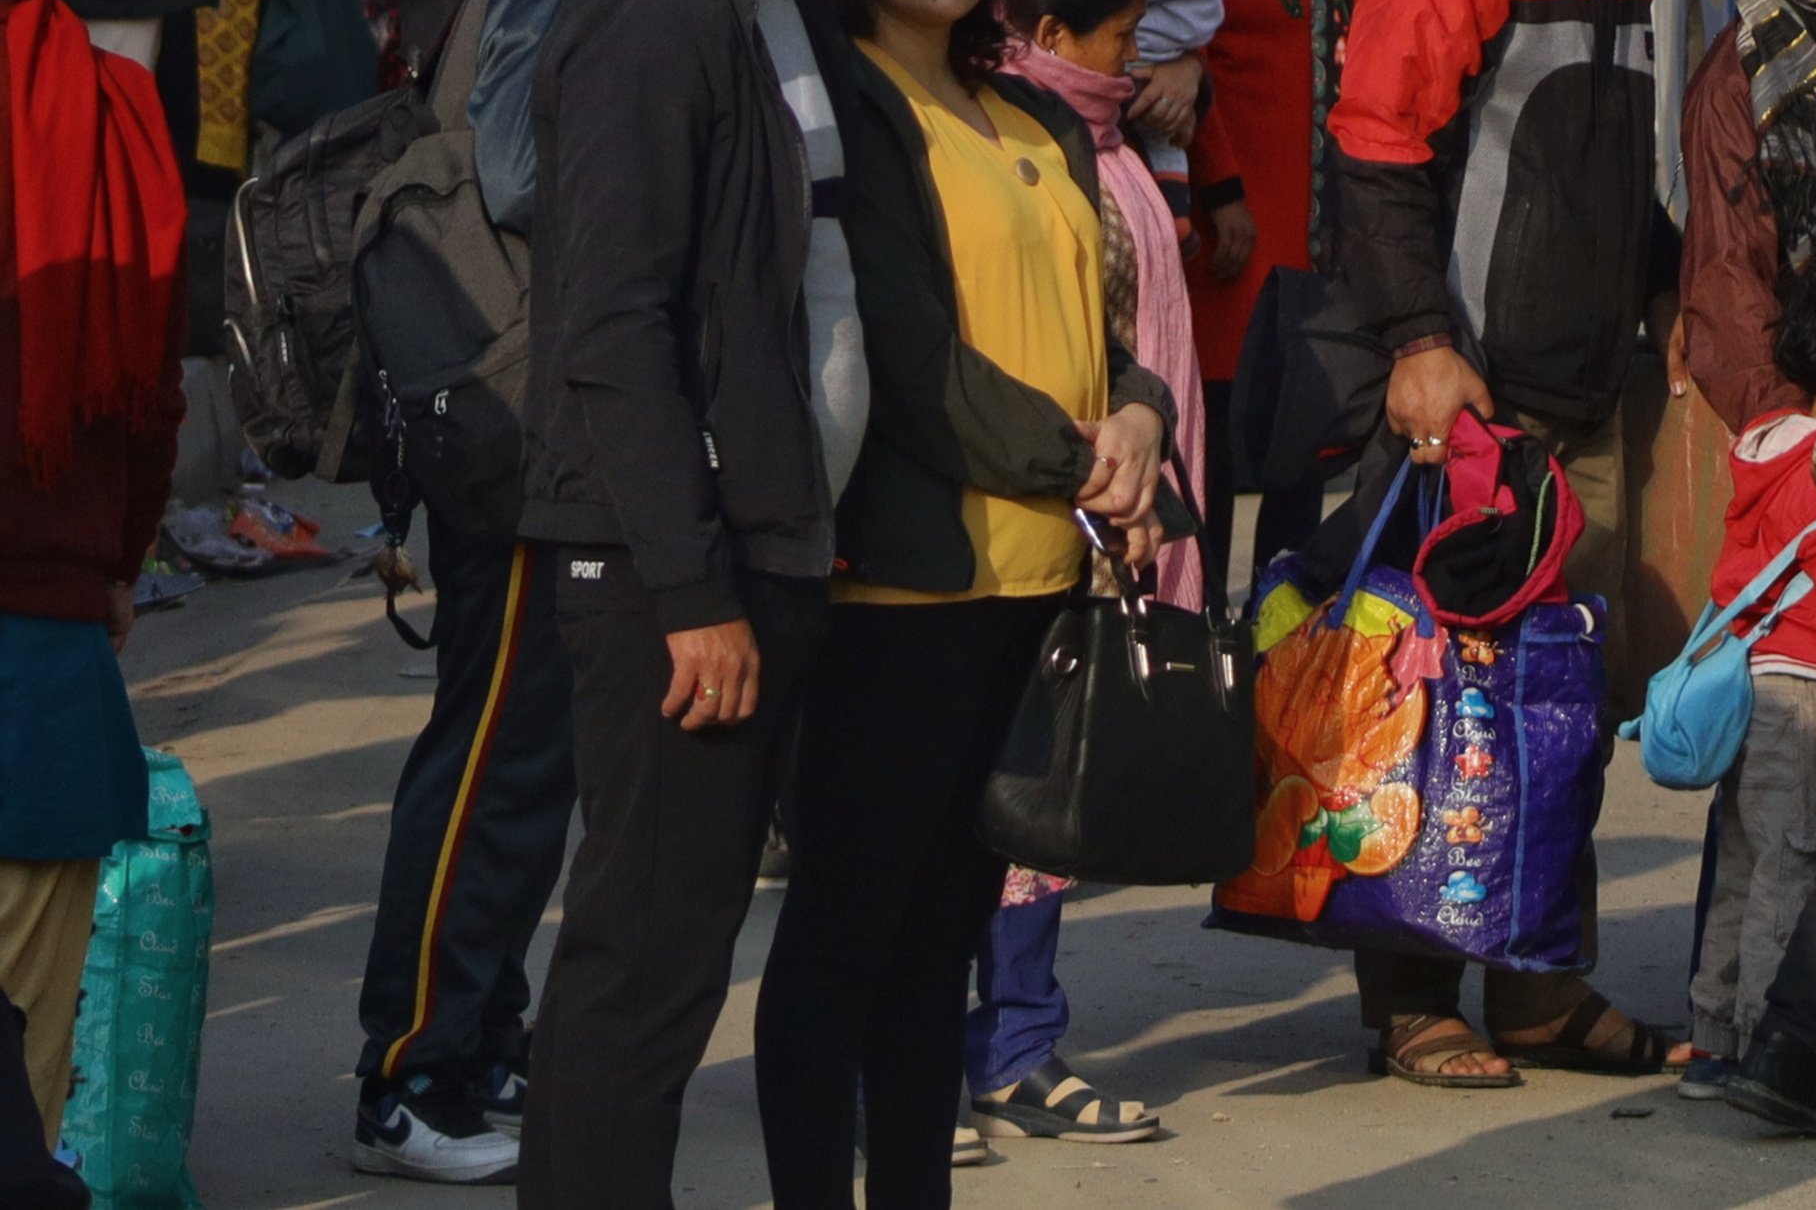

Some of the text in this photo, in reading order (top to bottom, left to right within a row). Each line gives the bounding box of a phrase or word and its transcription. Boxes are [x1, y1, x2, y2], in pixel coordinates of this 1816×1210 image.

[570, 560, 606, 579] SPORT
[1448, 777, 1490, 803] Star
[1447, 846, 1483, 867] Bee
[1436, 904, 1485, 927] Cloud
[139, 930, 178, 955] Cloud
[138, 975, 173, 1001] Star
[136, 1022, 166, 1047] Bee
